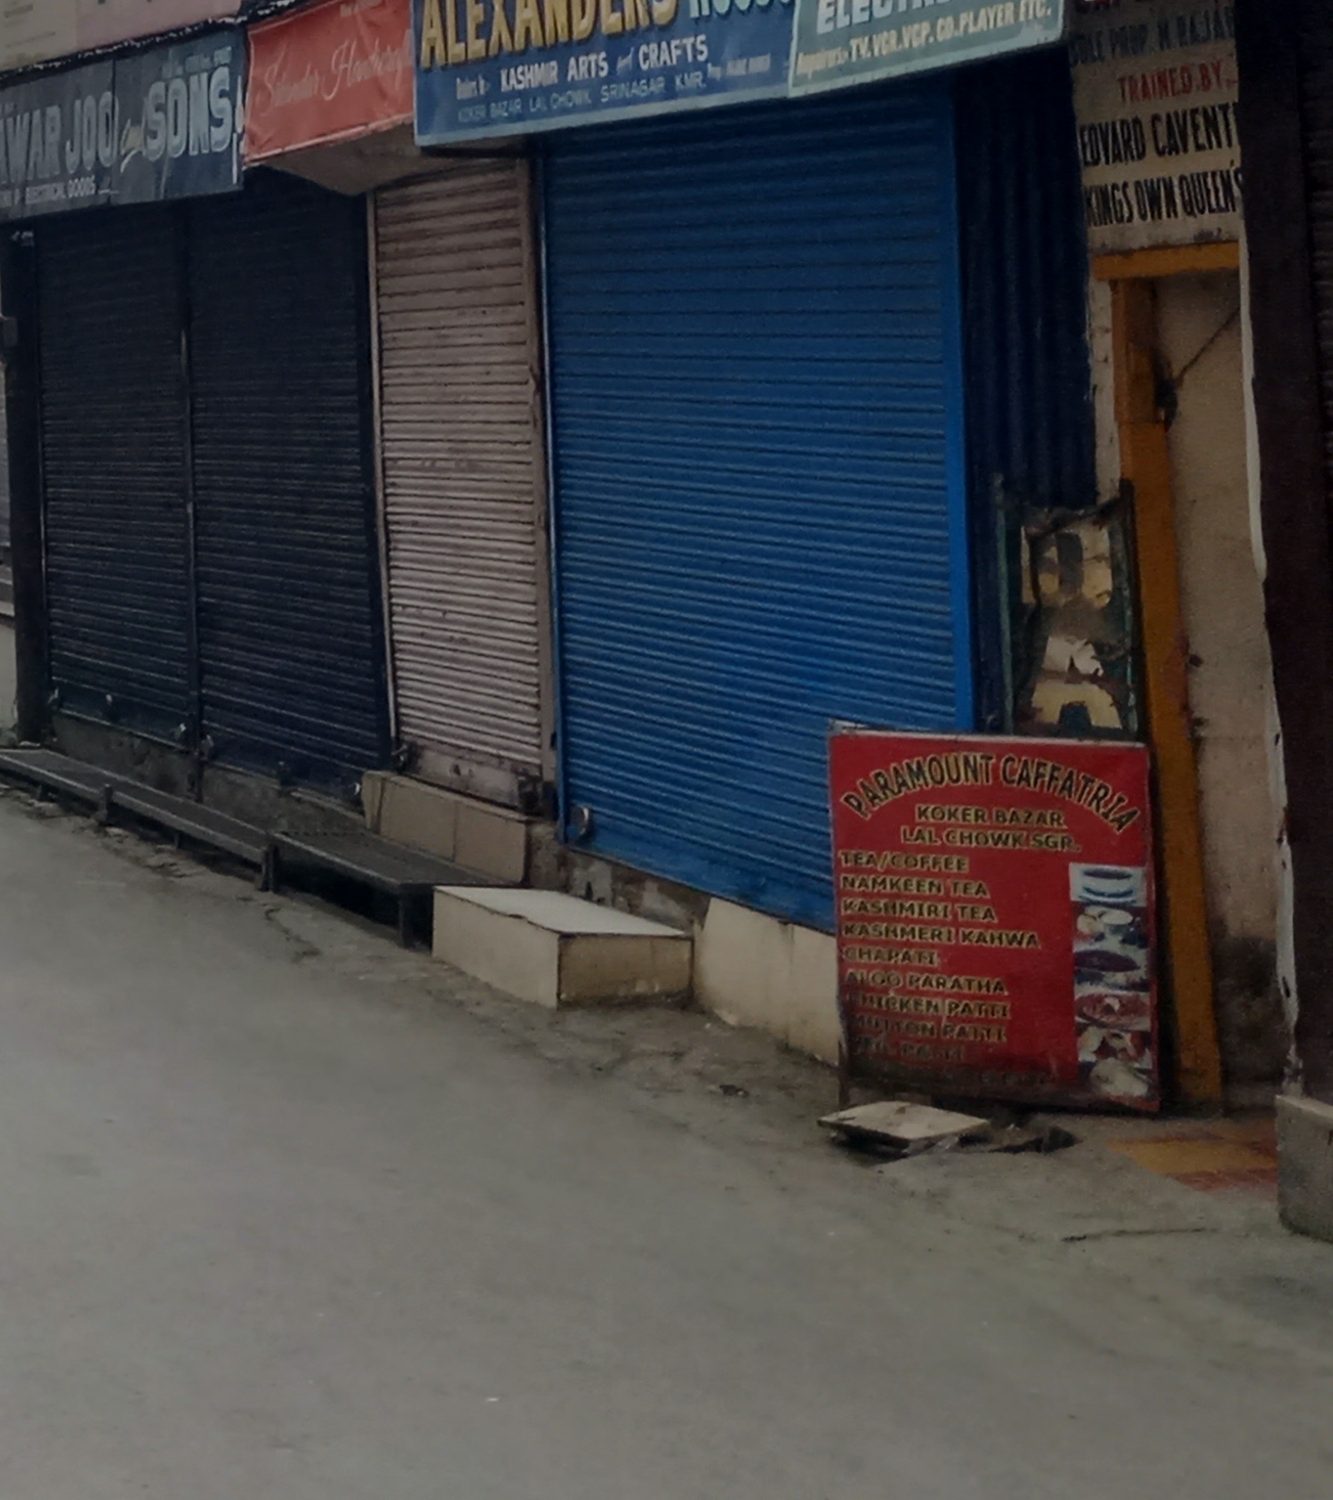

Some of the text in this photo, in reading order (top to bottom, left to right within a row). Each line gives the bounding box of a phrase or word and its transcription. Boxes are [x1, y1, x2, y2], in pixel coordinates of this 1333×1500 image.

[499, 60, 559, 93] KASHMIR
[566, 51, 609, 83] ARTS
[638, 32, 709, 71] CRAFTS
[600, 76, 666, 103] SRINAGAR
[65, 91, 120, 174] JOO
[144, 65, 233, 162] SONS
[1150, 100, 1239, 158] CAVENT
[1086, 179, 1134, 228] KINGS
[1134, 175, 1179, 223] OWN
[839, 750, 1142, 834] PARAMOUNT CAFFATRIA
[914, 803, 1068, 829] KOKER BAZAR
[901, 824, 1082, 852] LAL CHOWK SGR.
[837, 850, 970, 873] TEA/COFFEE
[839, 873, 991, 899] NAMKEEN TEA
[840, 897, 999, 924] KASHMIRI TEA
[841, 921, 1043, 950] KASHMERI KAHWA
[842, 945, 941, 967] CHAPATI
[905, 971, 1011, 997] PARATHA
[942, 997, 1012, 1021] PATTI
